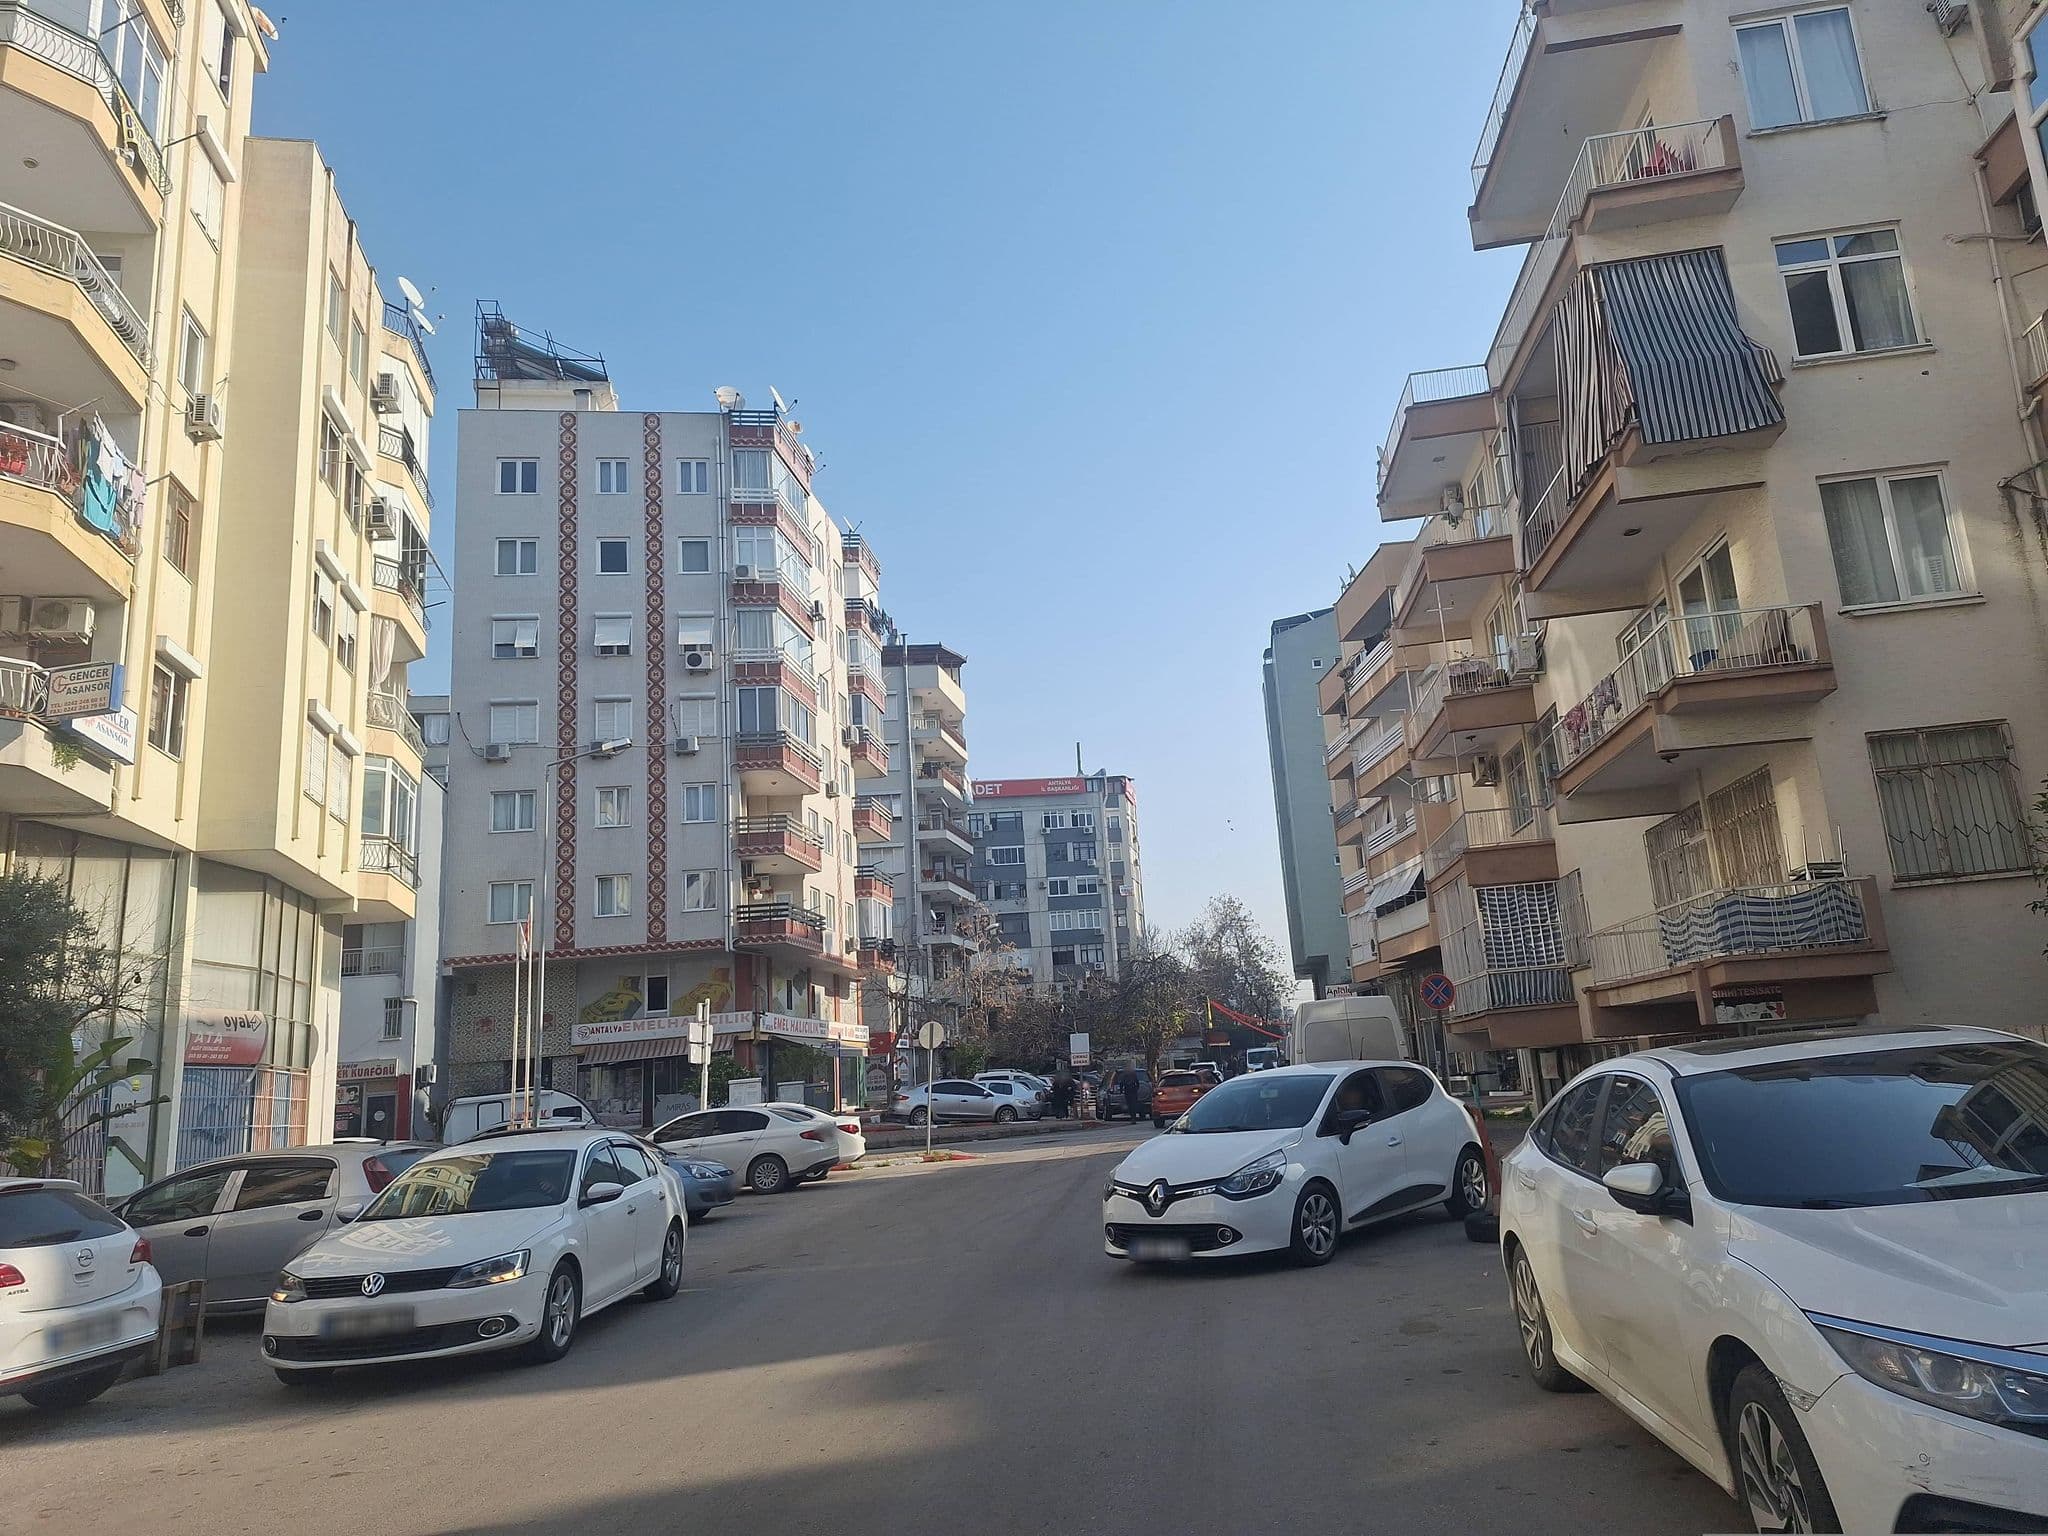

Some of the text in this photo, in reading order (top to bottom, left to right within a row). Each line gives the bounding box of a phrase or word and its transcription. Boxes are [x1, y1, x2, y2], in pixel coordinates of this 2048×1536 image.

[69, 668, 109, 681] GENCER
[104, 712, 130, 732] NCER
[590, 1024, 623, 1035] ANTALYA
